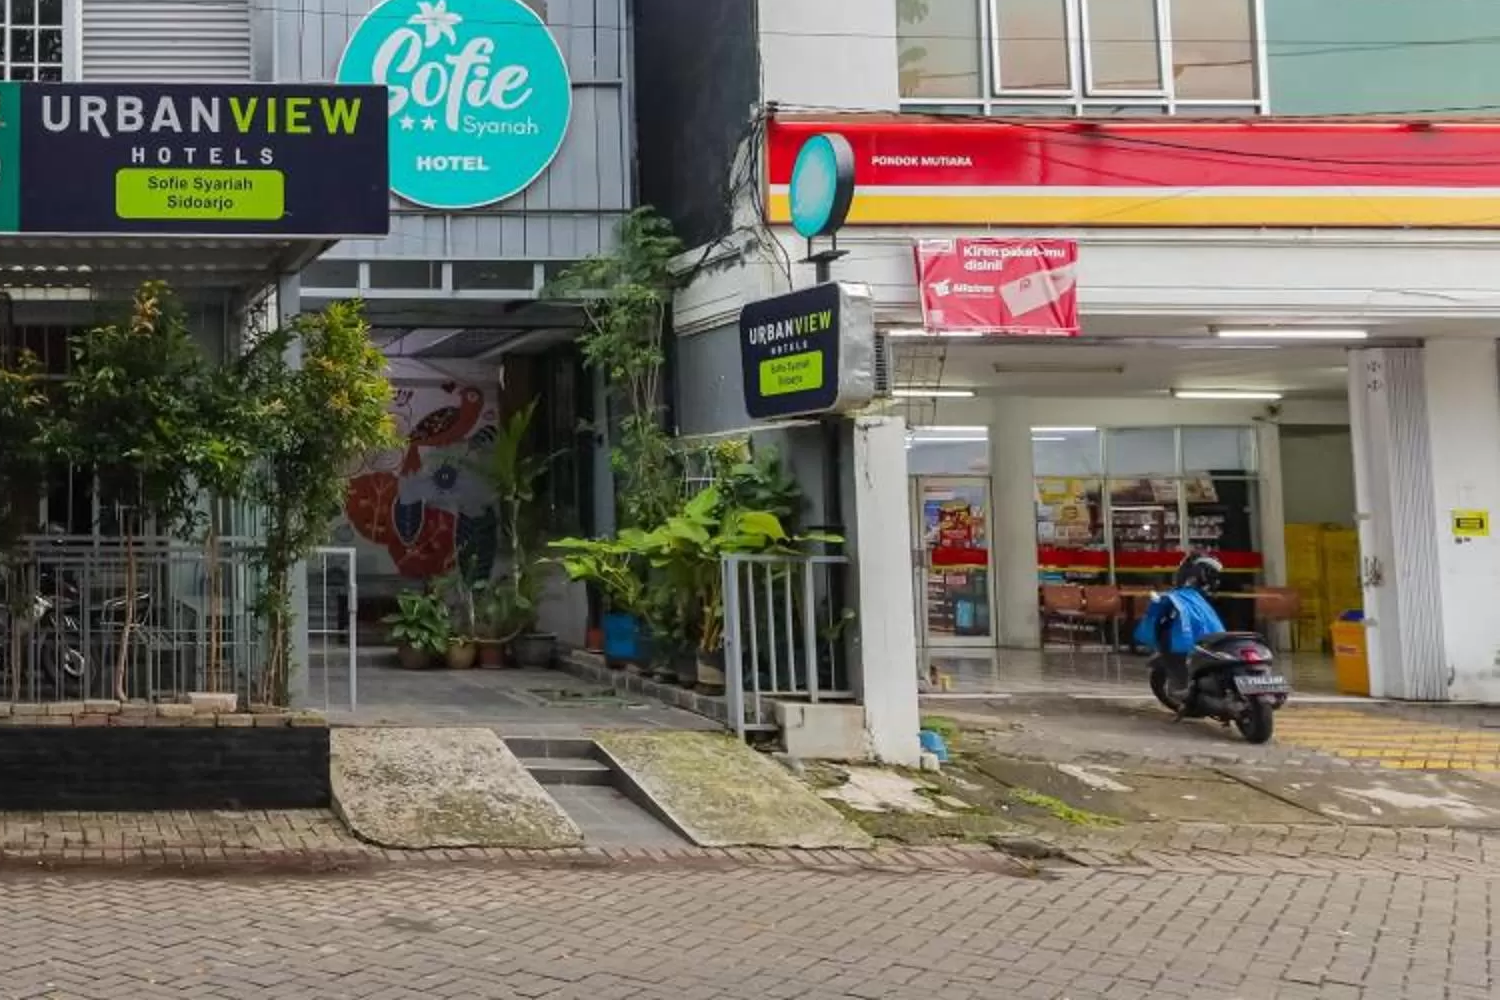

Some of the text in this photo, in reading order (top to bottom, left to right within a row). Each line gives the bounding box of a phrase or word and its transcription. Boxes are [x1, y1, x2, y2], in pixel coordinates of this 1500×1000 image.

[372, 28, 533, 132] Sofie
[41, 95, 362, 138] URBANVIEW
[463, 115, 539, 139] Syariah
[131, 147, 274, 164] HOTELS
[416, 155, 490, 171] HOTEL
[871, 155, 973, 168] PONDOK MUTIARA
[147, 175, 253, 193] Sofie Syariah
[166, 194, 234, 212] Sidoarjo
[964, 246, 1000, 258] Kirim
[749, 309, 832, 345] URBANVIEW
